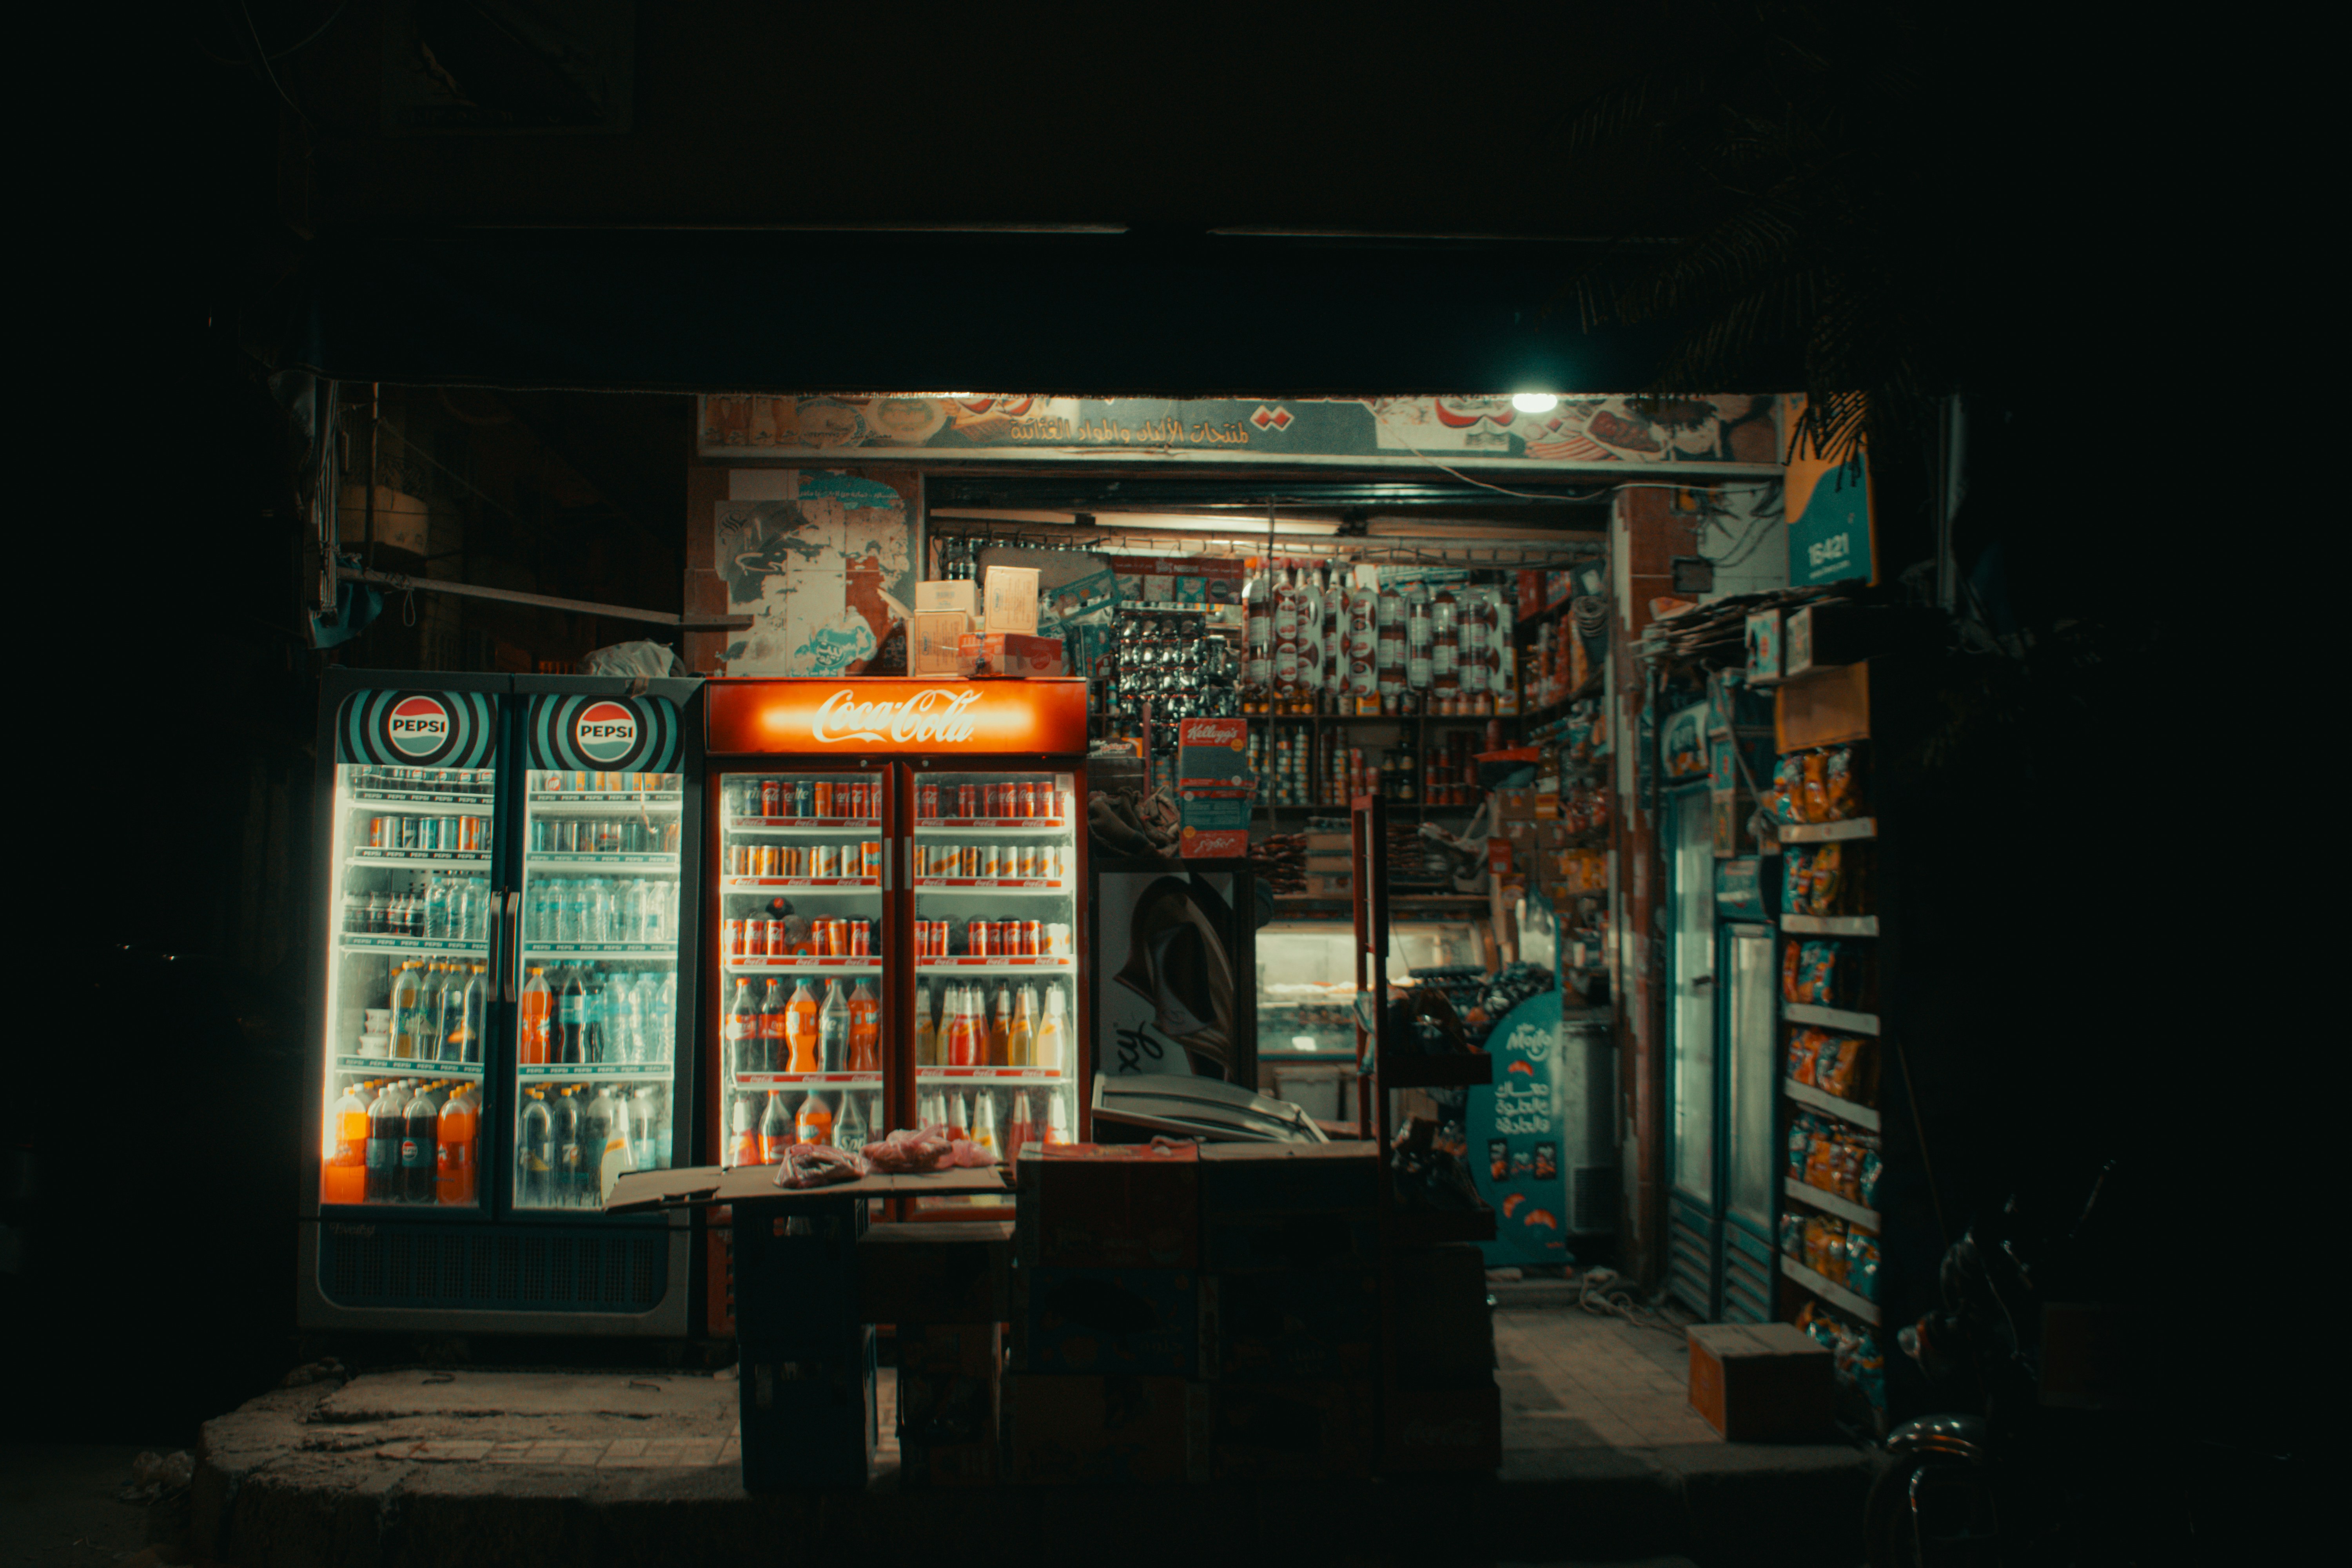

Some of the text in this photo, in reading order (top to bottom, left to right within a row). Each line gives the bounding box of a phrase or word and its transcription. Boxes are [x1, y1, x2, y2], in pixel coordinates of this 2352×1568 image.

[812, 688, 984, 743] Coca-Cola
[393, 719, 445, 733] PEPSI
[581, 725, 633, 739] PEPSI
